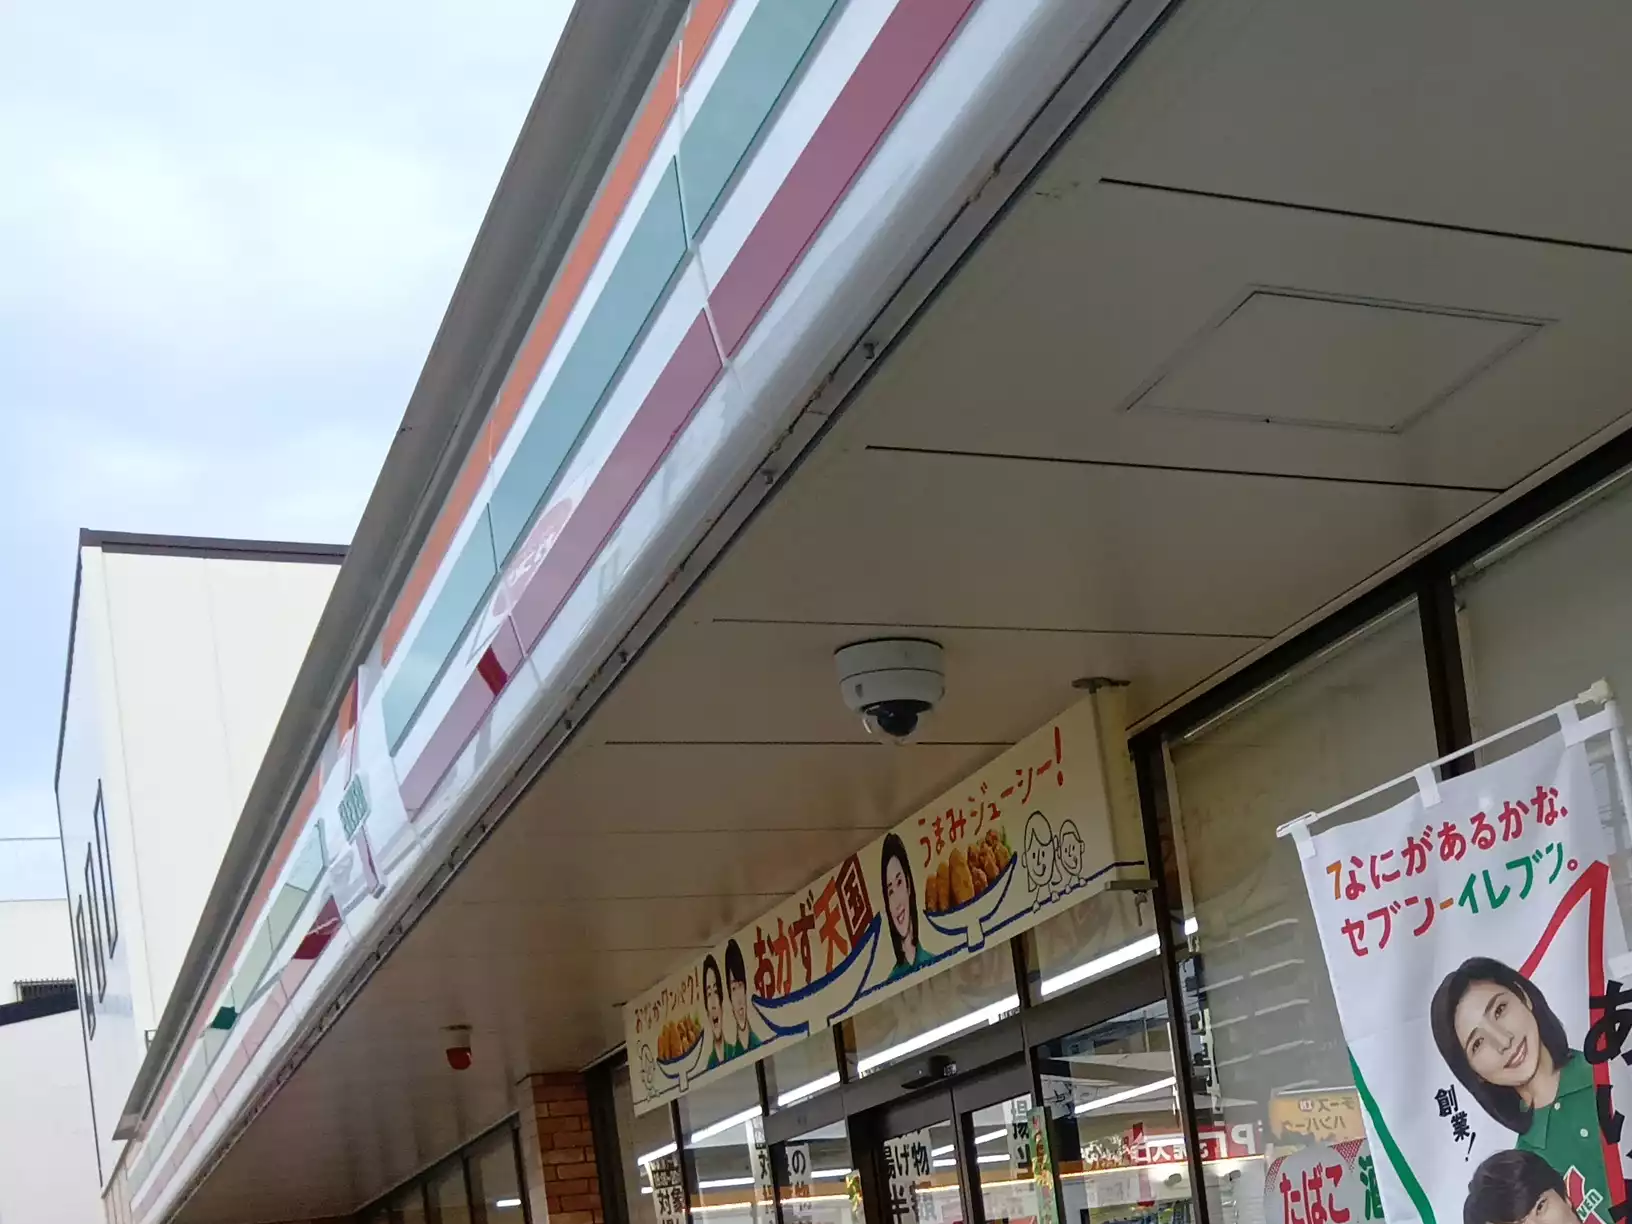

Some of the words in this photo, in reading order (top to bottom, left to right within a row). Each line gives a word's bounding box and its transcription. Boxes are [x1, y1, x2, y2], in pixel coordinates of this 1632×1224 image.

[753, 852, 874, 999] おかず天国
